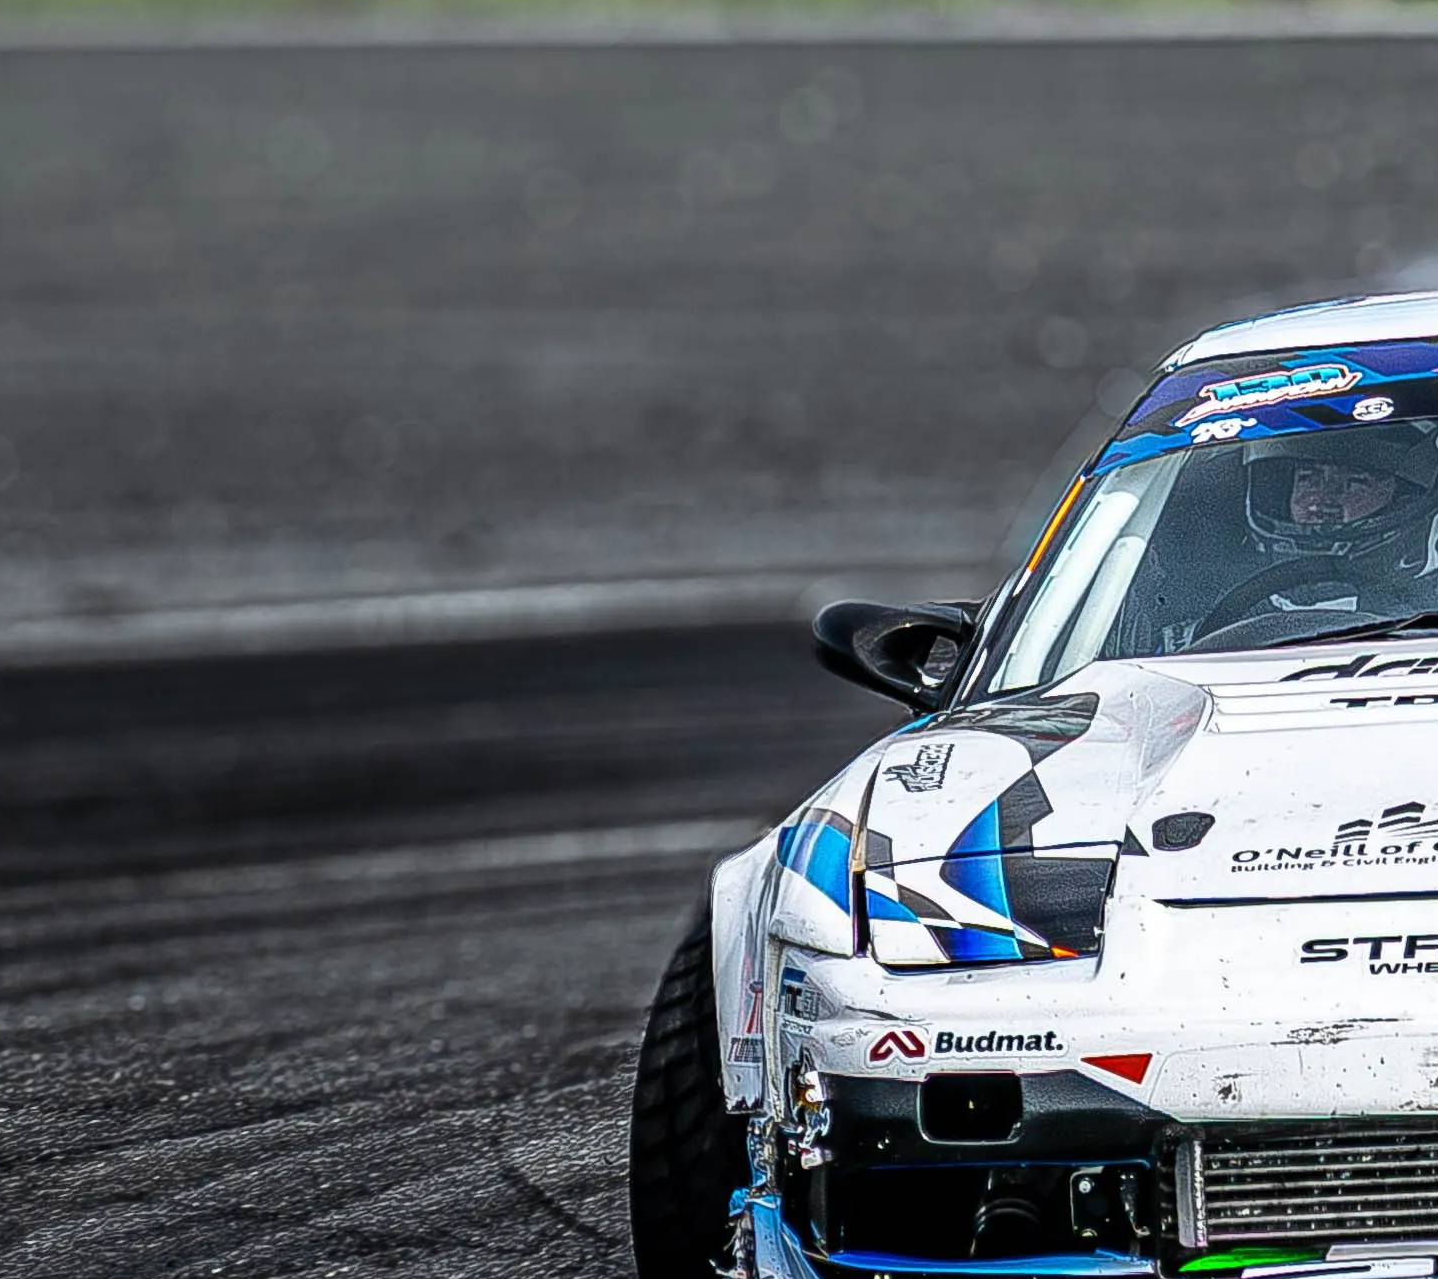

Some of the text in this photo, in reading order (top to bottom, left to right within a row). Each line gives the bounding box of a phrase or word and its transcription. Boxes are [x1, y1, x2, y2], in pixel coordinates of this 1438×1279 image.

[1230, 861, 1316, 873] Building
[1342, 855, 1389, 867] Civil
[1231, 840, 1368, 864] O'Neill
[1380, 839, 1423, 856] of
[935, 1030, 1065, 1055] Budmat.
